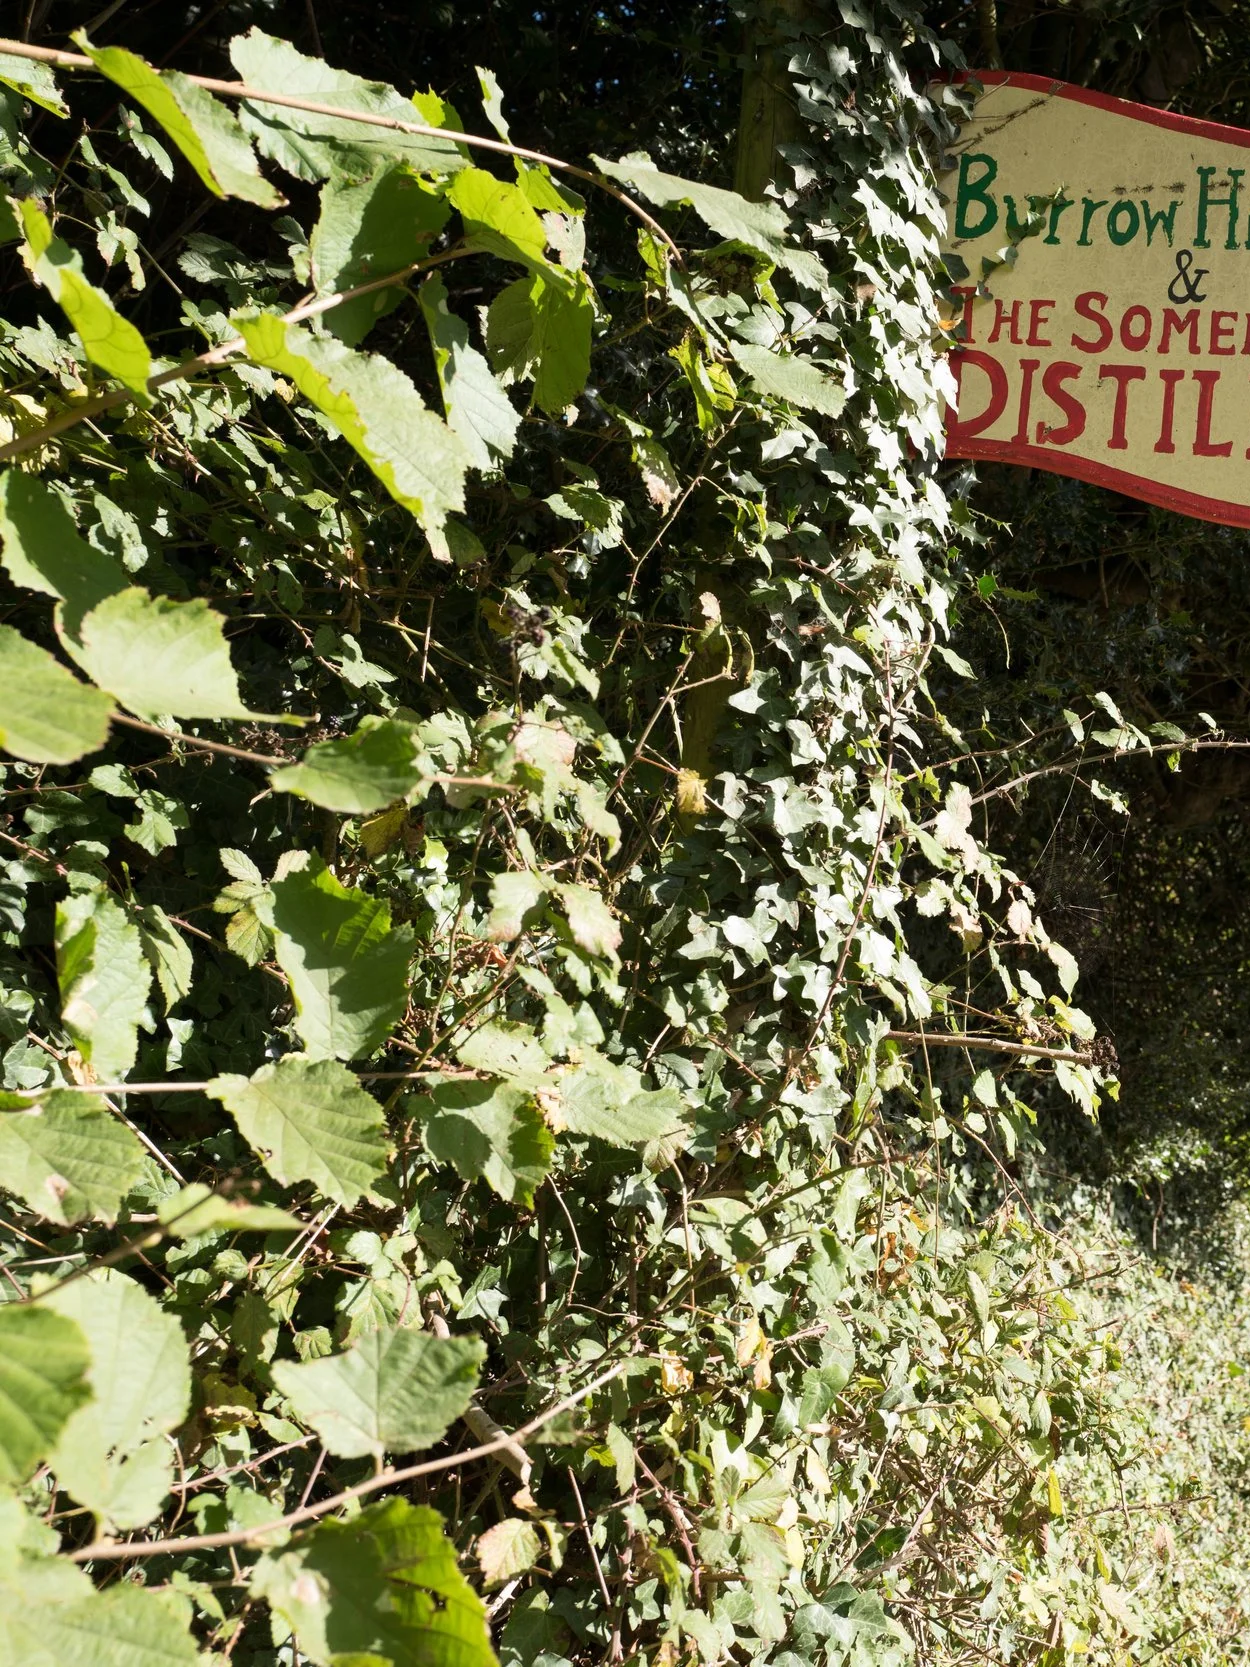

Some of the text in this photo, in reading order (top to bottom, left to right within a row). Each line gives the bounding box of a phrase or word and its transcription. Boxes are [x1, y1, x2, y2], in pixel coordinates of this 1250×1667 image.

[955, 153, 1184, 247] Burrow
[1168, 249, 1210, 304] &
[950, 286, 1056, 347] THE
